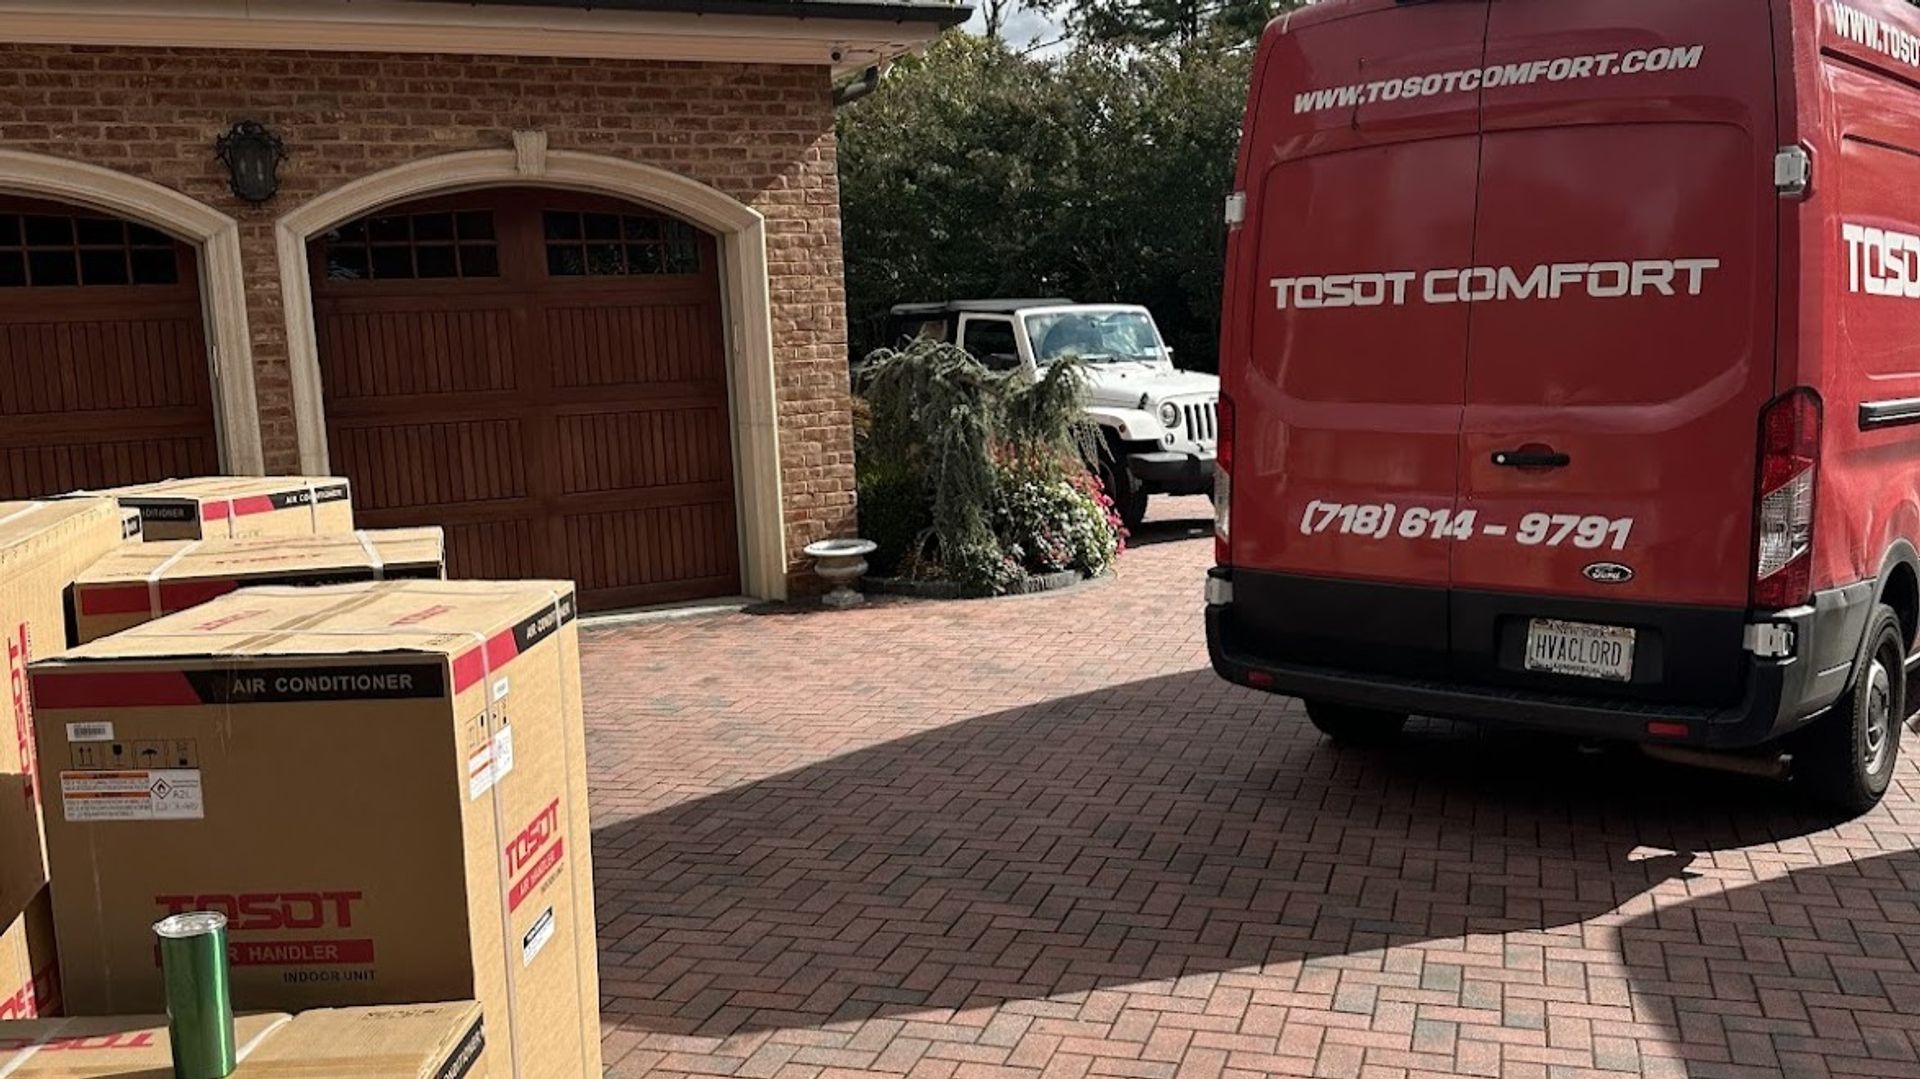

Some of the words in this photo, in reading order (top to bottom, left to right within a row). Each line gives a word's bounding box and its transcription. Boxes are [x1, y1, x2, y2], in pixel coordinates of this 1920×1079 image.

[1294, 45, 1703, 113] WWW.TOSOTCOMFORT.COM
[1270, 272, 1415, 310] TOSOT
[1424, 258, 1720, 303] COMFORT
[1300, 500, 1396, 539] (718)
[1399, 507, 1477, 540] 614
[1516, 513, 1634, 550] 9791
[1591, 567, 1622, 579] Ford
[1535, 634, 1622, 667] HVACLORD
[232, 679, 267, 694] AIR
[274, 673, 414, 693] CONDITIONER
[505, 798, 560, 880] TOSOT
[249, 944, 339, 963] HANDLER
[283, 970, 341, 984] INDOOR
[343, 969, 376, 982] UNIT
